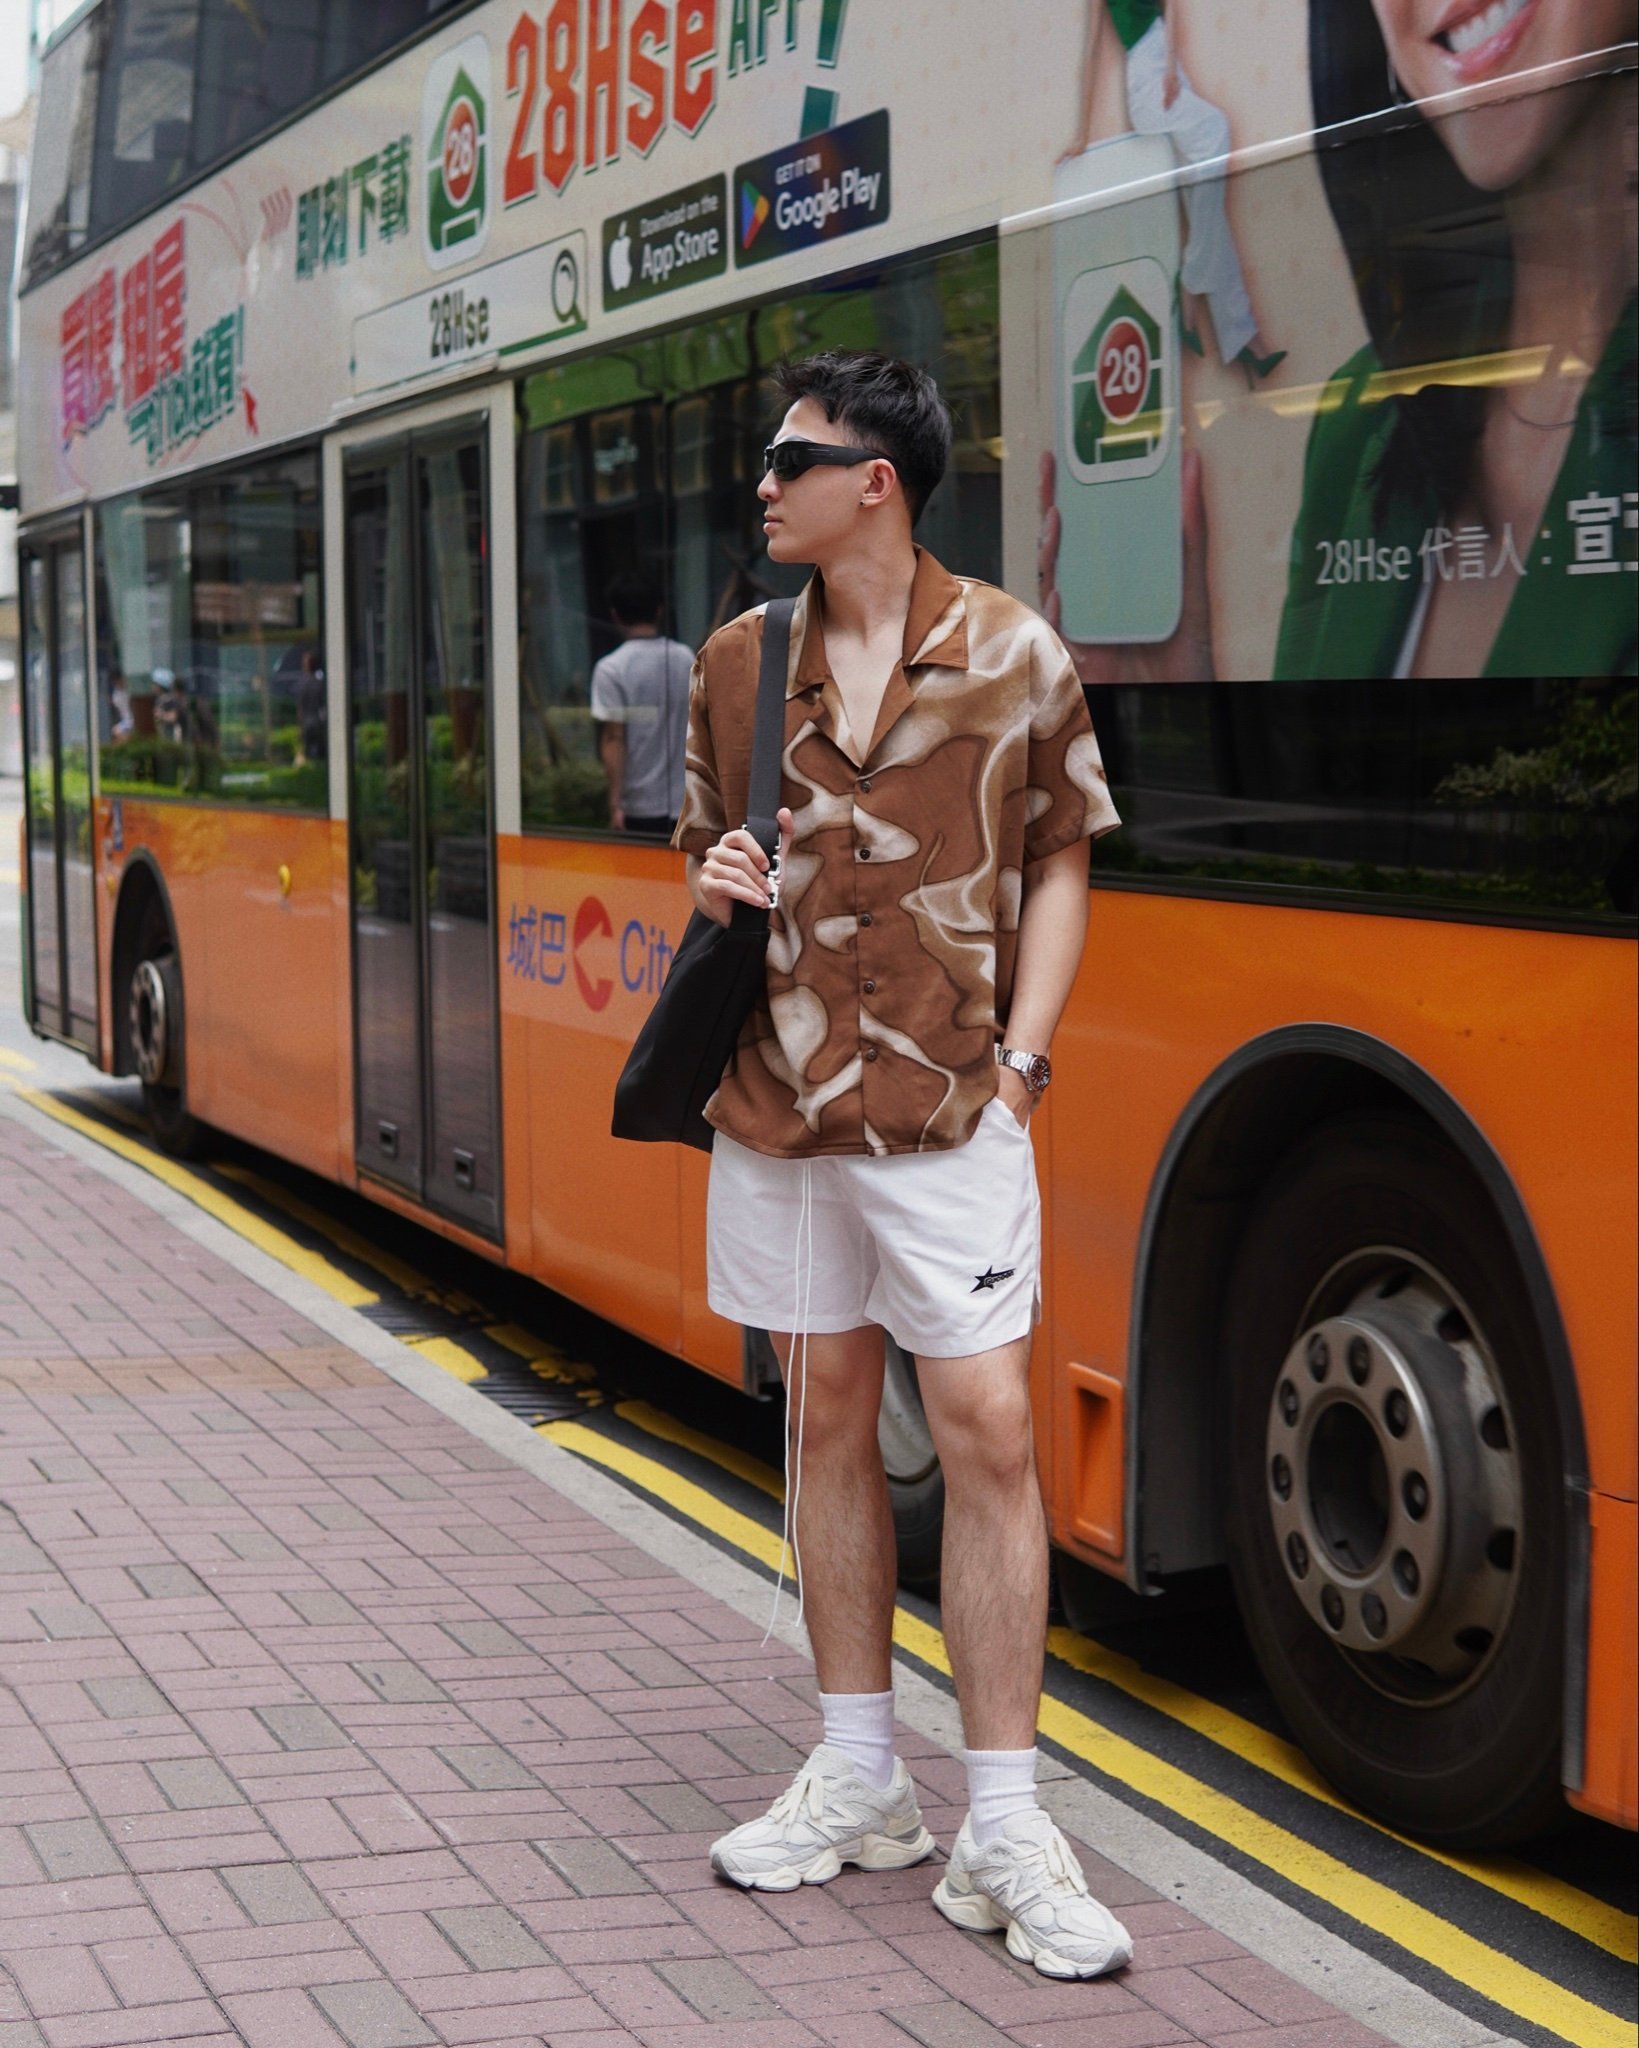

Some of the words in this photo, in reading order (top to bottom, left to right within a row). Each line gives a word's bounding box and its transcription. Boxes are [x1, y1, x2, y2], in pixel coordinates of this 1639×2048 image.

[503, 0, 717, 210] 28Hse
[446, 132, 475, 185] 28
[775, 164, 794, 185] GET
[805, 153, 822, 173] ON
[296, 134, 412, 281] 即刻下載
[640, 201, 686, 238] Download
[700, 193, 718, 212] the
[775, 178, 839, 230] Google
[842, 166, 881, 211] Play
[641, 243, 674, 284] App
[675, 228, 718, 267] Store
[429, 289, 489, 359] 28Hse
[1102, 344, 1141, 397] 28
[1315, 538, 1411, 585] 28Hse
[1566, 491, 1638, 575] 宣
[507, 902, 567, 985] 城巴
